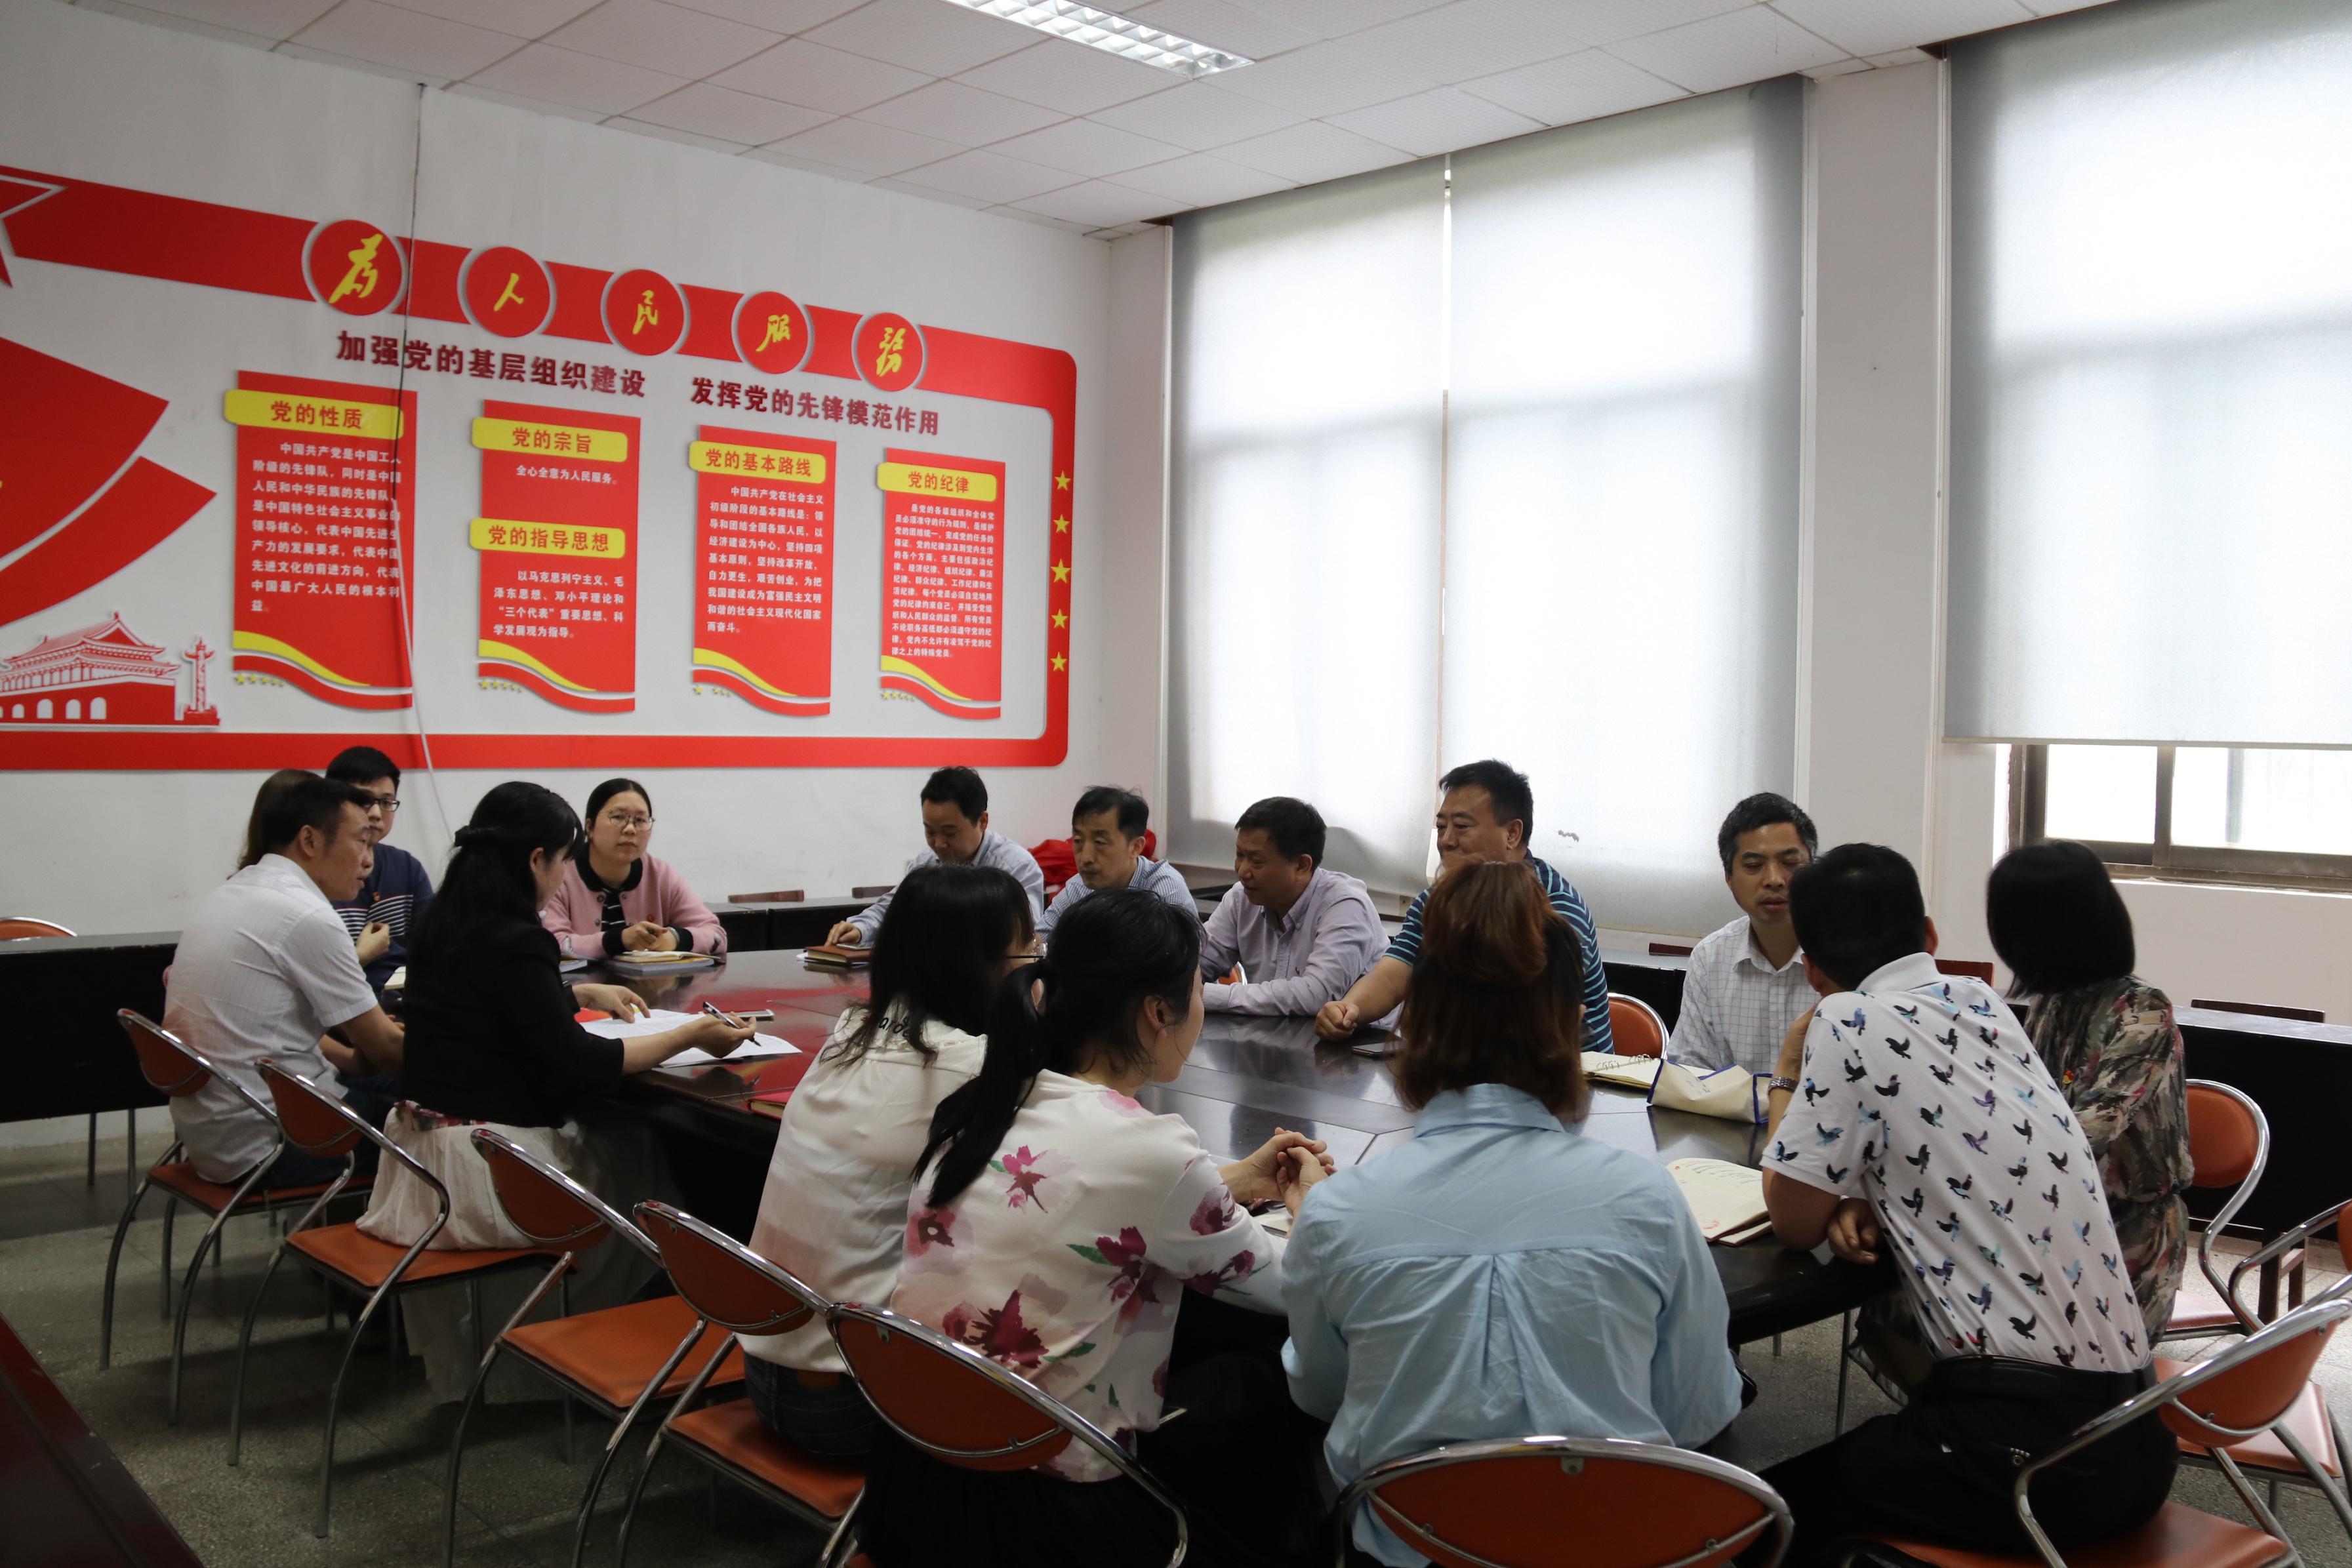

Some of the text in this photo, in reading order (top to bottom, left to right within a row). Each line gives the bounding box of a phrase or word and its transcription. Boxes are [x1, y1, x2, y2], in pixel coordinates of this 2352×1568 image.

[336, 330, 939, 436] 加强党的基层组织建设 发挥党的先锋模范作用
[271, 400, 362, 430] 党的性质
[512, 427, 591, 454] 党的宗旨
[706, 449, 811, 477] 党的基本路线
[516, 465, 617, 485] 全心全意为人民服务。
[908, 471, 969, 493] 党的纪律
[731, 486, 824, 504] 中国共产党在社会主义
[710, 501, 824, 521] 初级阶段的基本路线是：领
[710, 518, 823, 537] 导和团结全国各族人民，以
[489, 525, 609, 552] 党的指导思想
[709, 536, 822, 553] 经济建设为中心，坚持四项
[517, 571, 624, 587] 以马克思列宁主义、毛
[251, 580, 399, 597] 中国最广大人民的根本利
[494, 587, 623, 604] 泽东思想、邓小平理论和
[708, 587, 821, 603] 我国建设成为富强民主文明
[707, 604, 821, 620] 和谐的社会主义现代化国家
[494, 624, 574, 639] 学发展观为指导。
[707, 621, 740, 633] 而奋斗。
